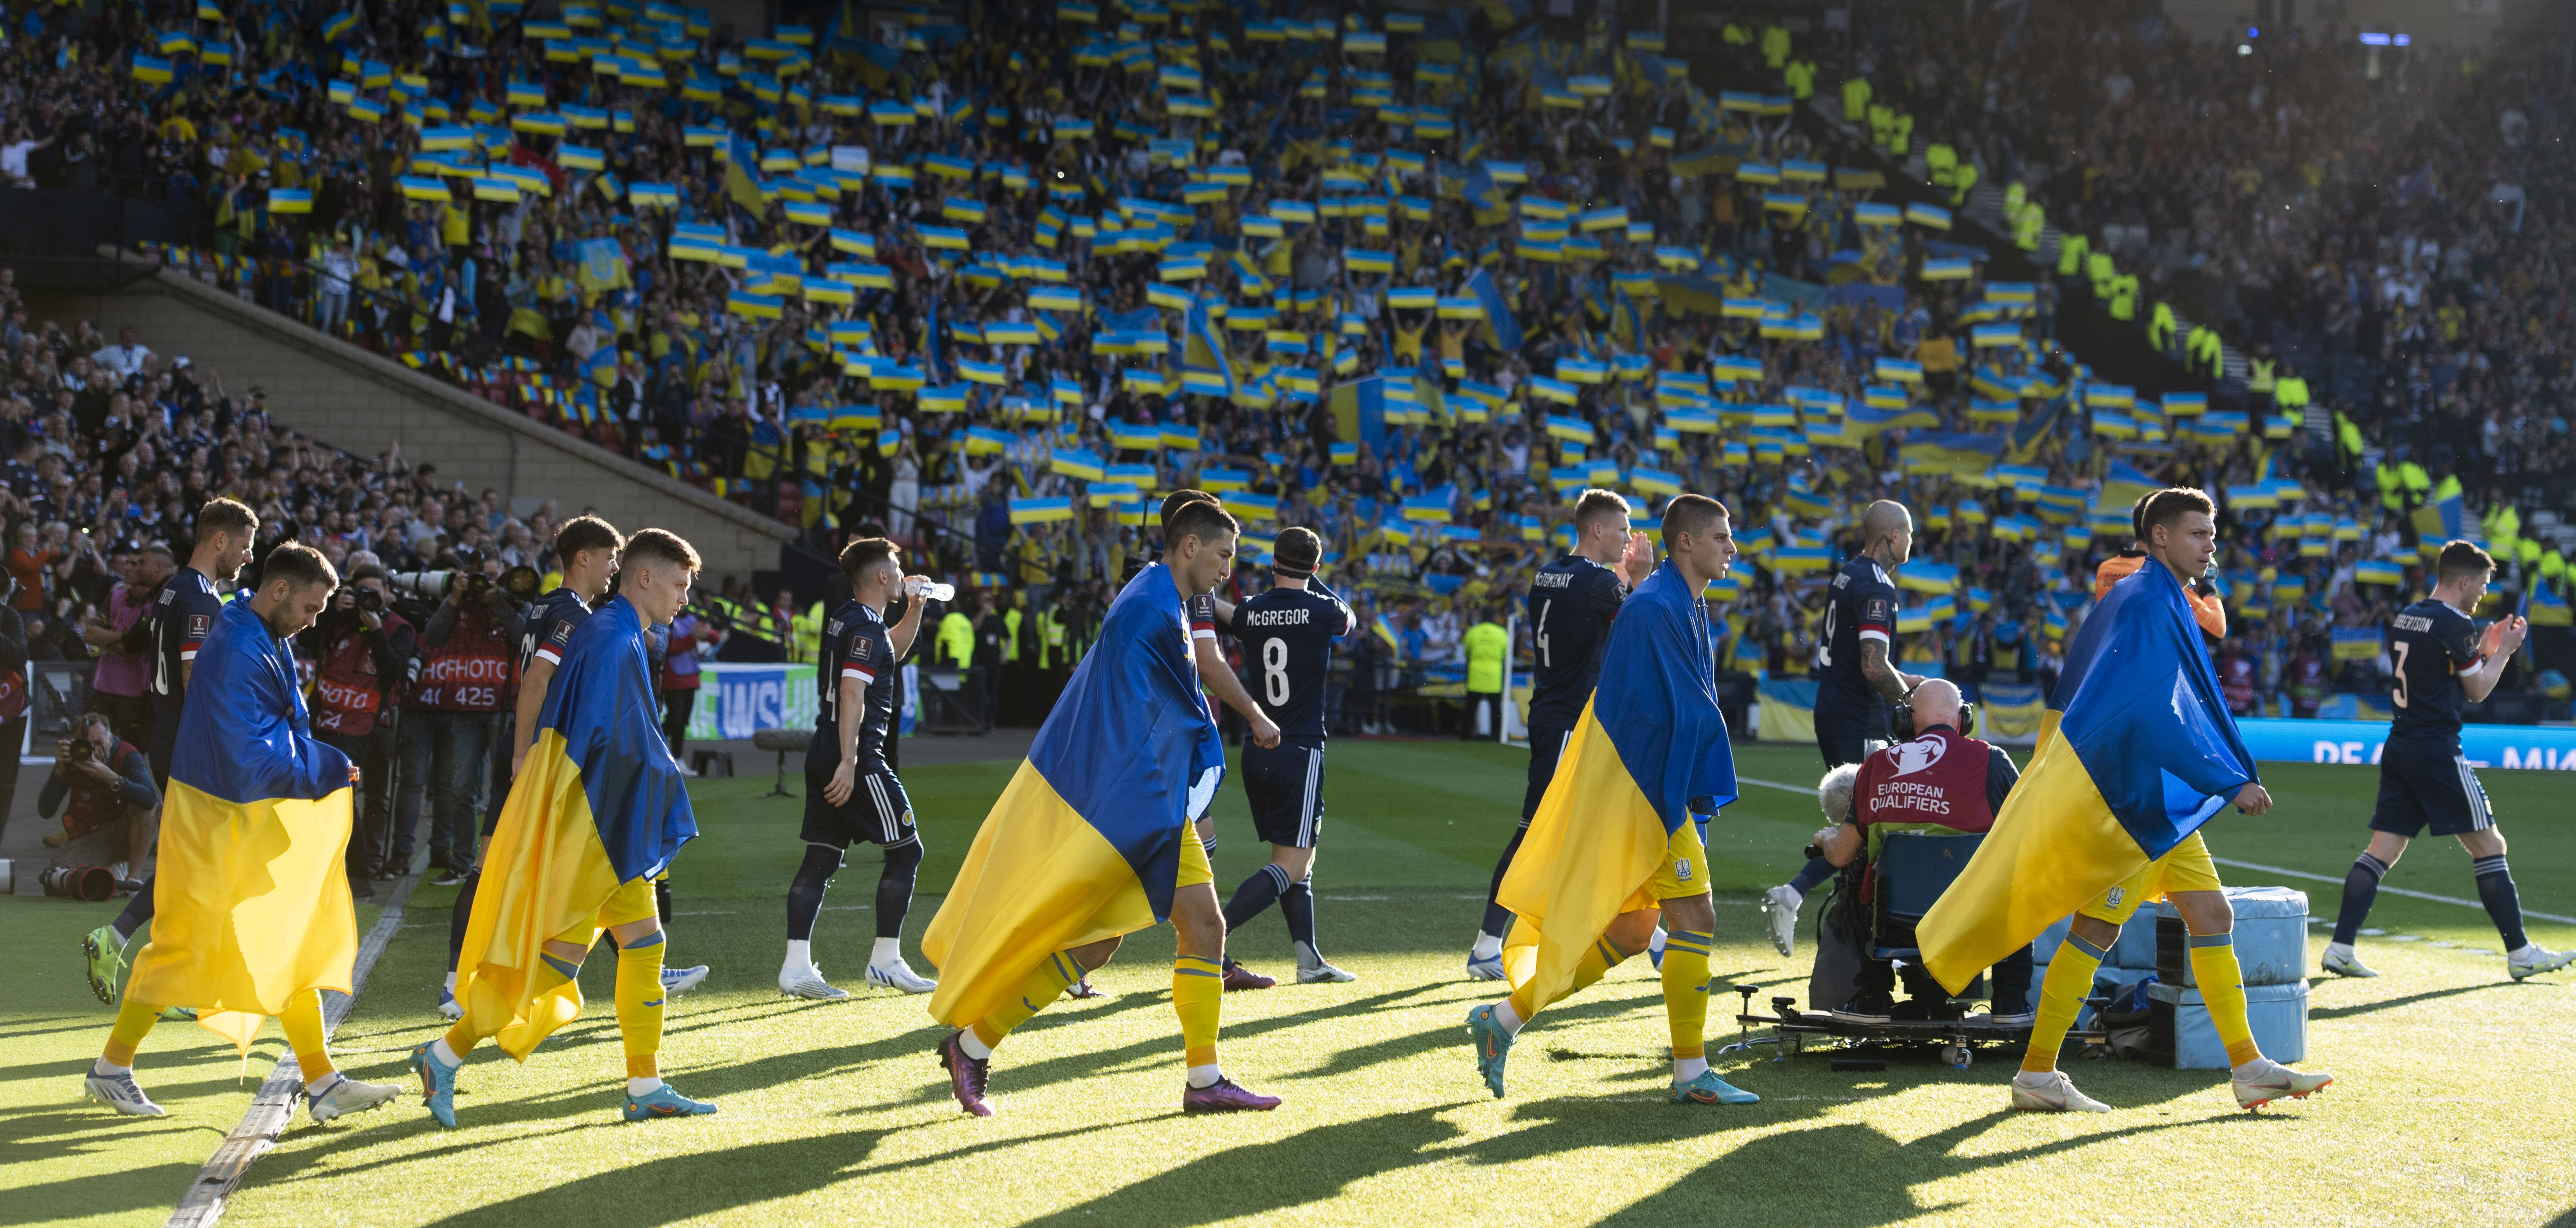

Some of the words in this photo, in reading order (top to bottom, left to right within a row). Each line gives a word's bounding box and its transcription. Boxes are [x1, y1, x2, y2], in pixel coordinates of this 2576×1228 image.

[1247, 609, 1309, 626] McGREGOR
[2393, 614, 2434, 633] OBERTSON
[1537, 599, 1551, 667] 4
[1263, 637, 1290, 706] 8
[2393, 641, 2409, 708] 3
[455, 687, 495, 705] 425
[1878, 782, 1943, 799] EUROPEAN
[1870, 795, 1950, 815] QUALIFIERS
